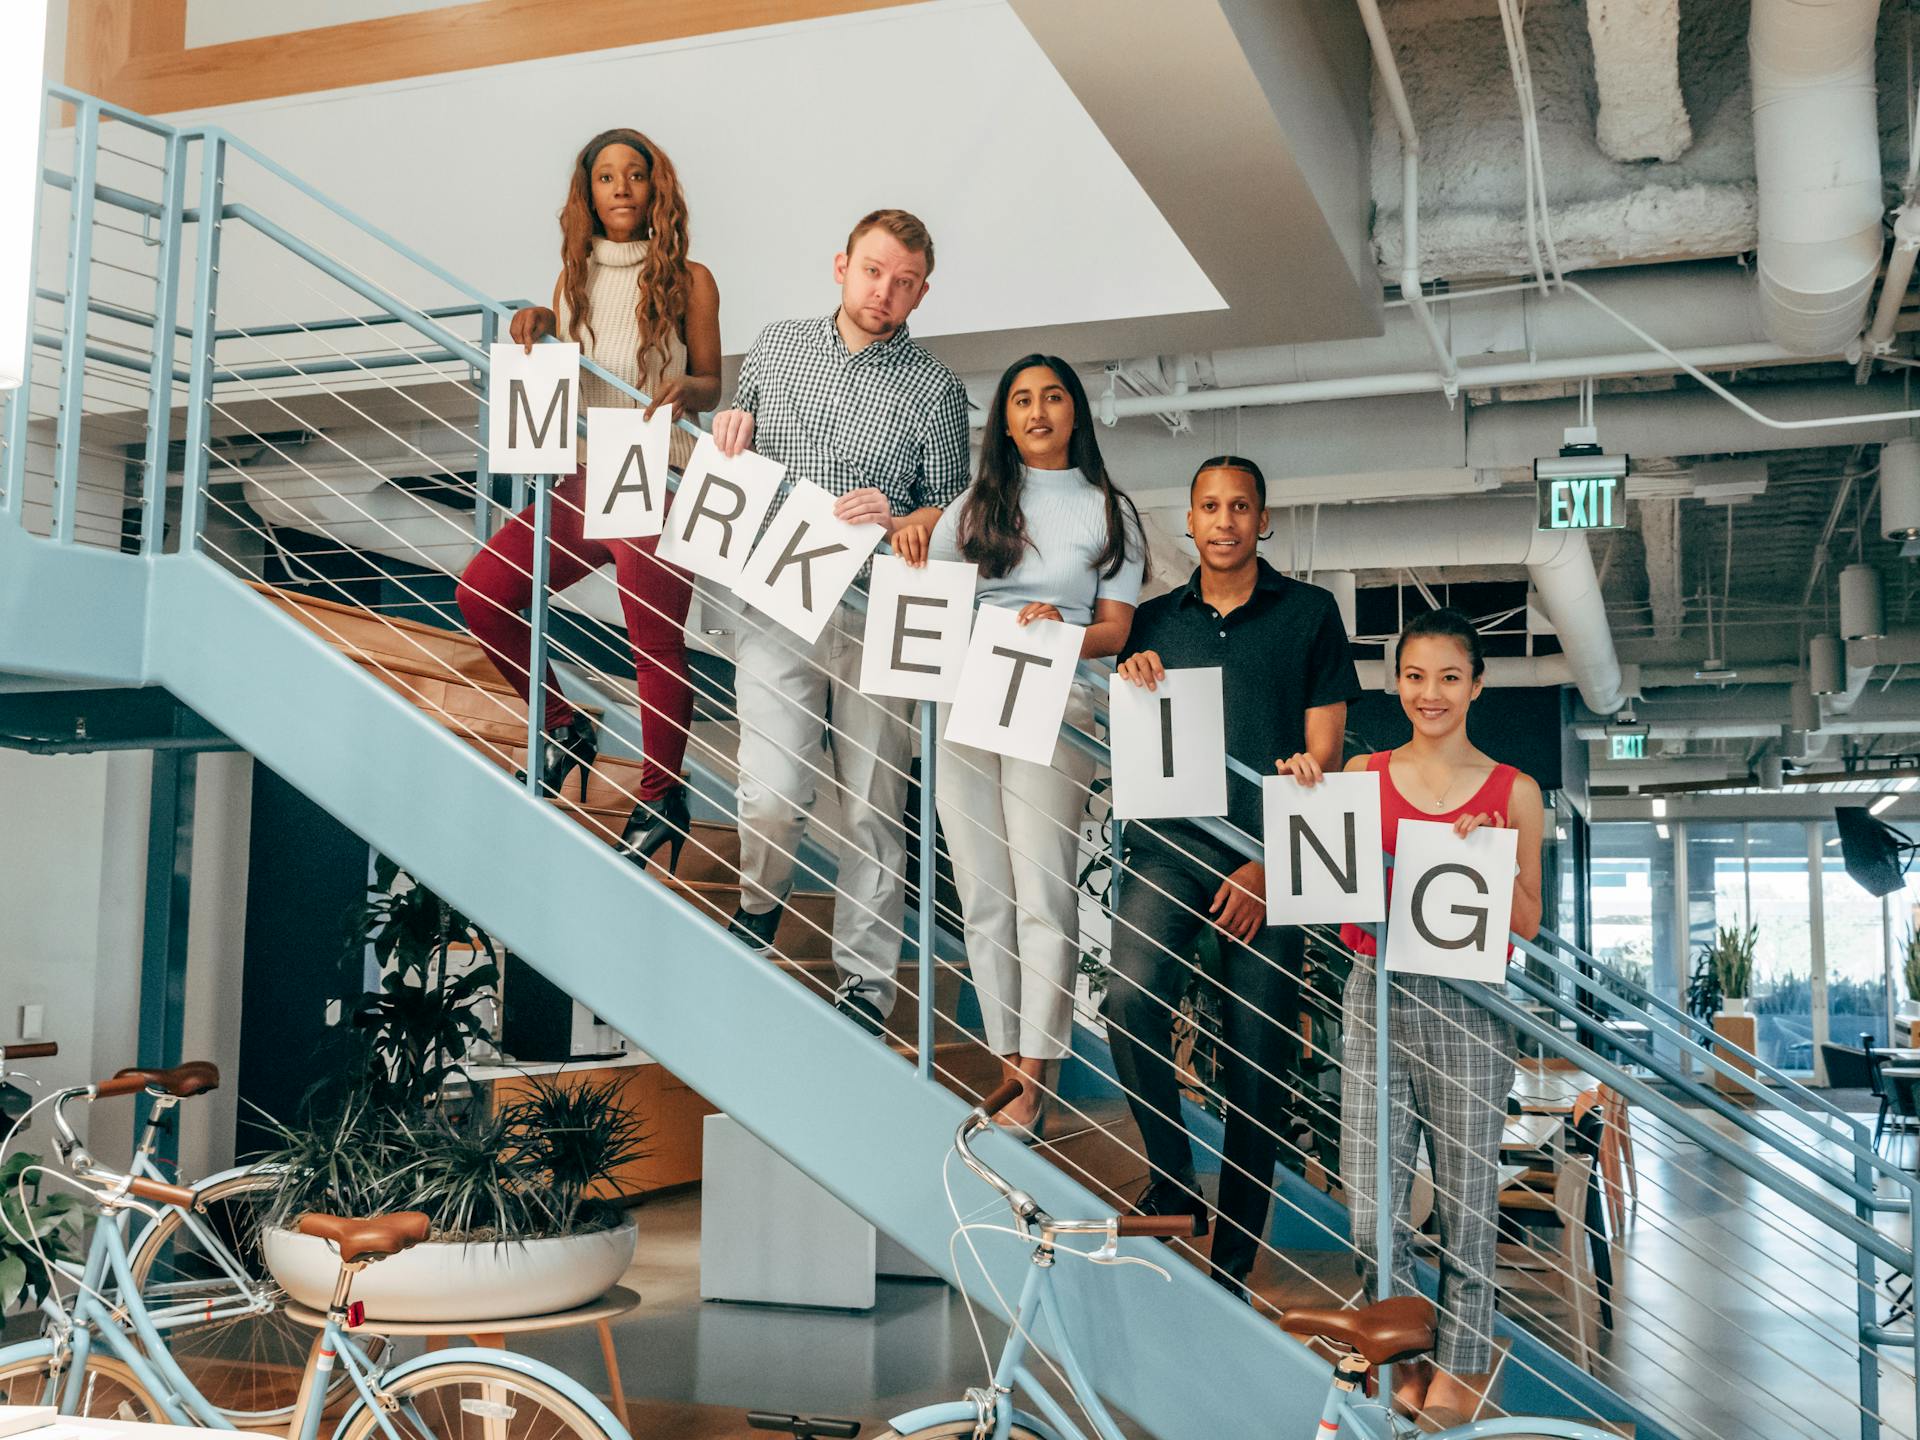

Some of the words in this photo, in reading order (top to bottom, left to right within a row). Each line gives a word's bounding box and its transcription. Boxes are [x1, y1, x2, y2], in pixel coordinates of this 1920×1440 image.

[508, 378, 570, 449] M
[601, 444, 653, 515] A
[681, 472, 747, 559] R
[1551, 479, 1617, 529] EXIT
[764, 519, 850, 613] K
[890, 594, 948, 675] E
[992, 645, 1053, 728] T
[1159, 697, 1174, 778] I
[1612, 735, 1645, 759] EXIT
[1289, 811, 1358, 896] N
[1410, 863, 1489, 952] G
